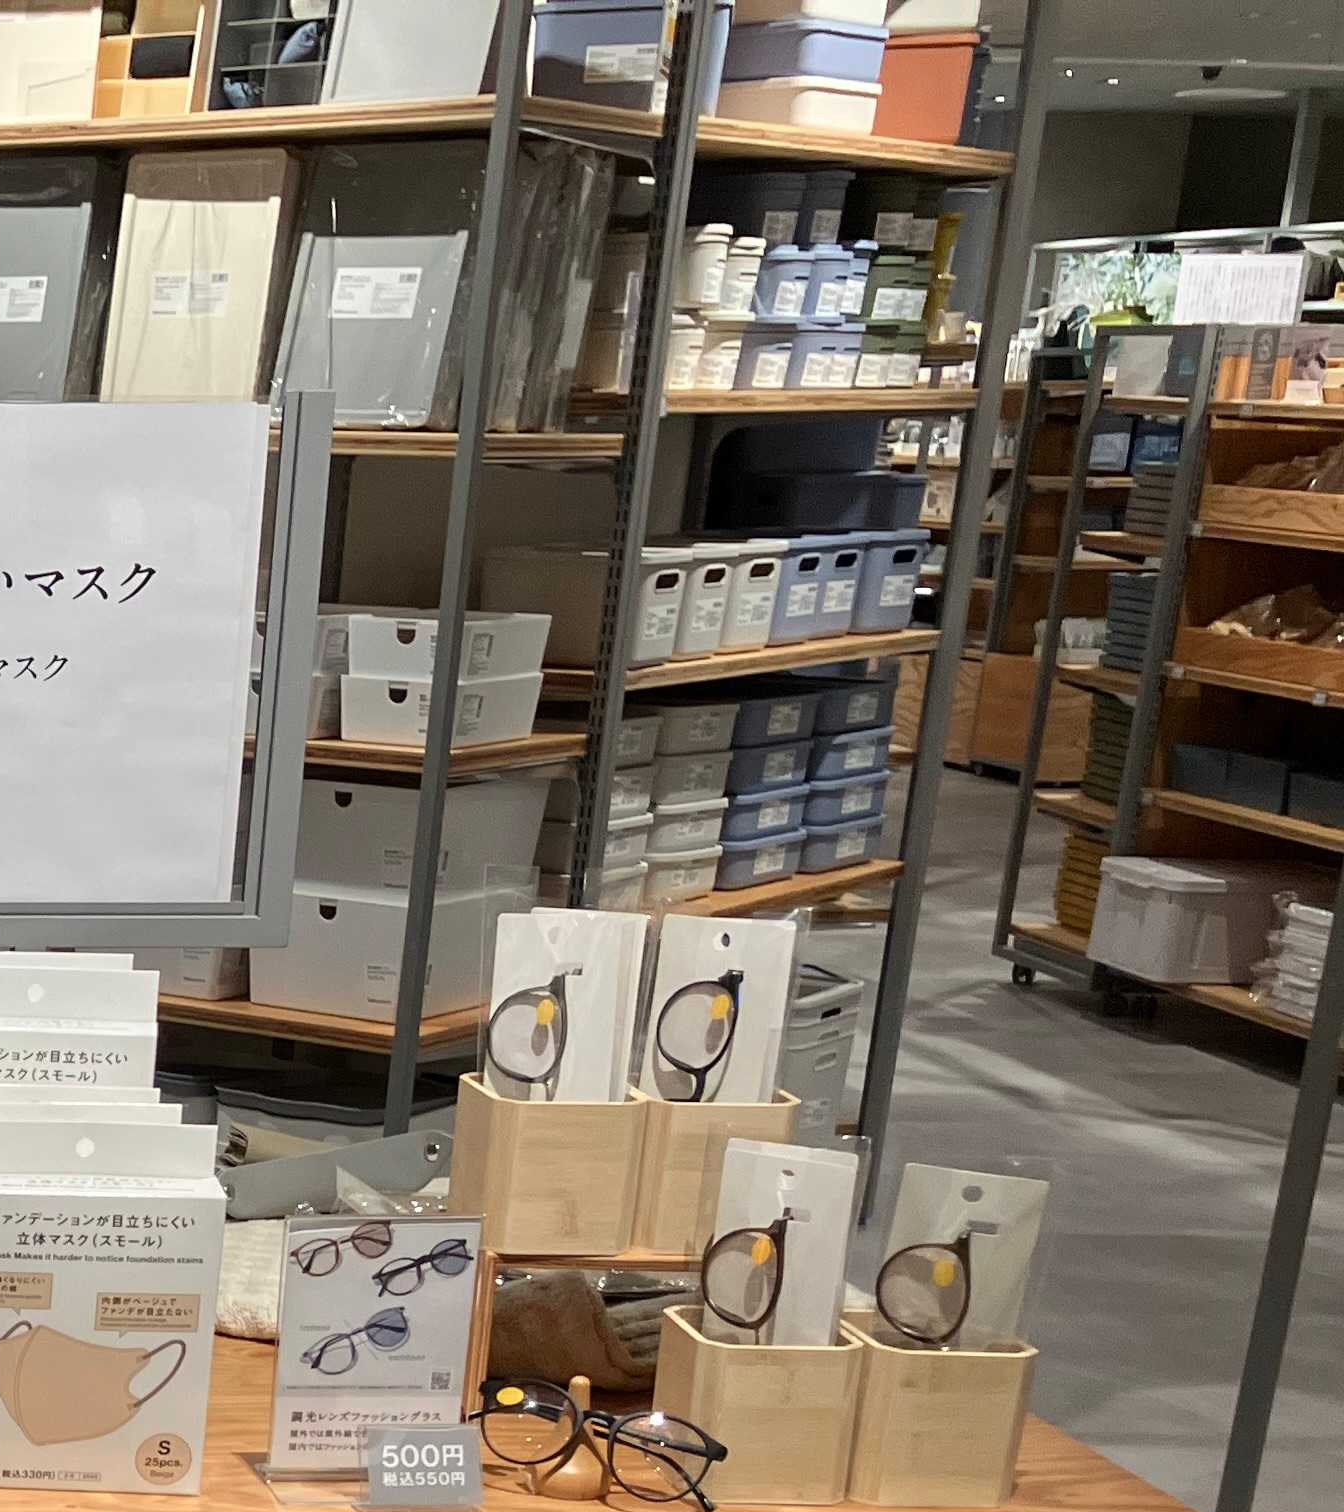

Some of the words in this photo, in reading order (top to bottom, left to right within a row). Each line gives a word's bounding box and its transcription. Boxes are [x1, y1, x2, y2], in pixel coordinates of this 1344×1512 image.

[16, 1232, 163, 1248] 立体マスク(スモール)
[158, 1439, 171, 1456] S
[381, 1444, 464, 1468] 500円
[382, 1471, 466, 1487] 税込550円
